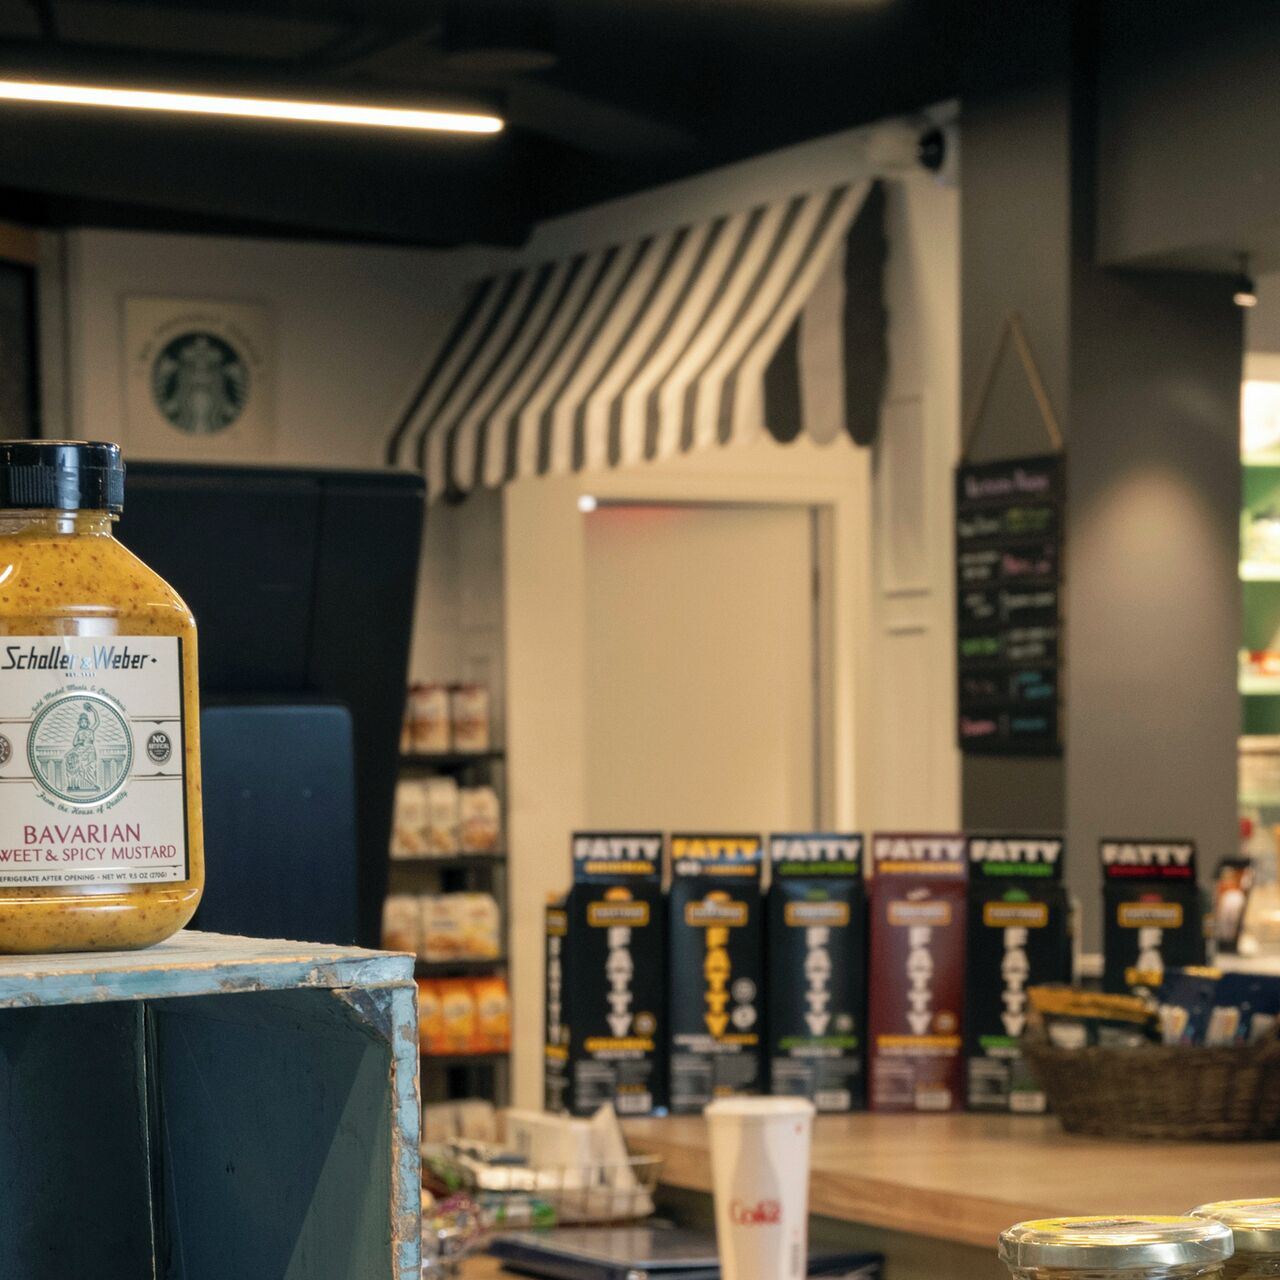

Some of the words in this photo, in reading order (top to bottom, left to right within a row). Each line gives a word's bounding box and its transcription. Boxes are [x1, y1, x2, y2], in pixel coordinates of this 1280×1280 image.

[1, 646, 79, 670] Schaller
[93, 645, 149, 670] Weber
[23, 823, 141, 845] BAVARIAN
[45, 848, 59, 862] &
[62, 847, 106, 862] SPICY
[111, 844, 176, 860] MUSTARD
[574, 838, 661, 859] FATTY
[671, 839, 759, 859] FATTY
[771, 839, 860, 860] FATTY
[875, 839, 964, 859] FATTY
[970, 841, 1061, 861] FATTY
[1102, 843, 1193, 864] FATTY
[41, 874, 63, 882] AFTER
[64, 873, 95, 881] OPENING
[102, 873, 114, 881] NET
[138, 872, 148, 880] OZ
